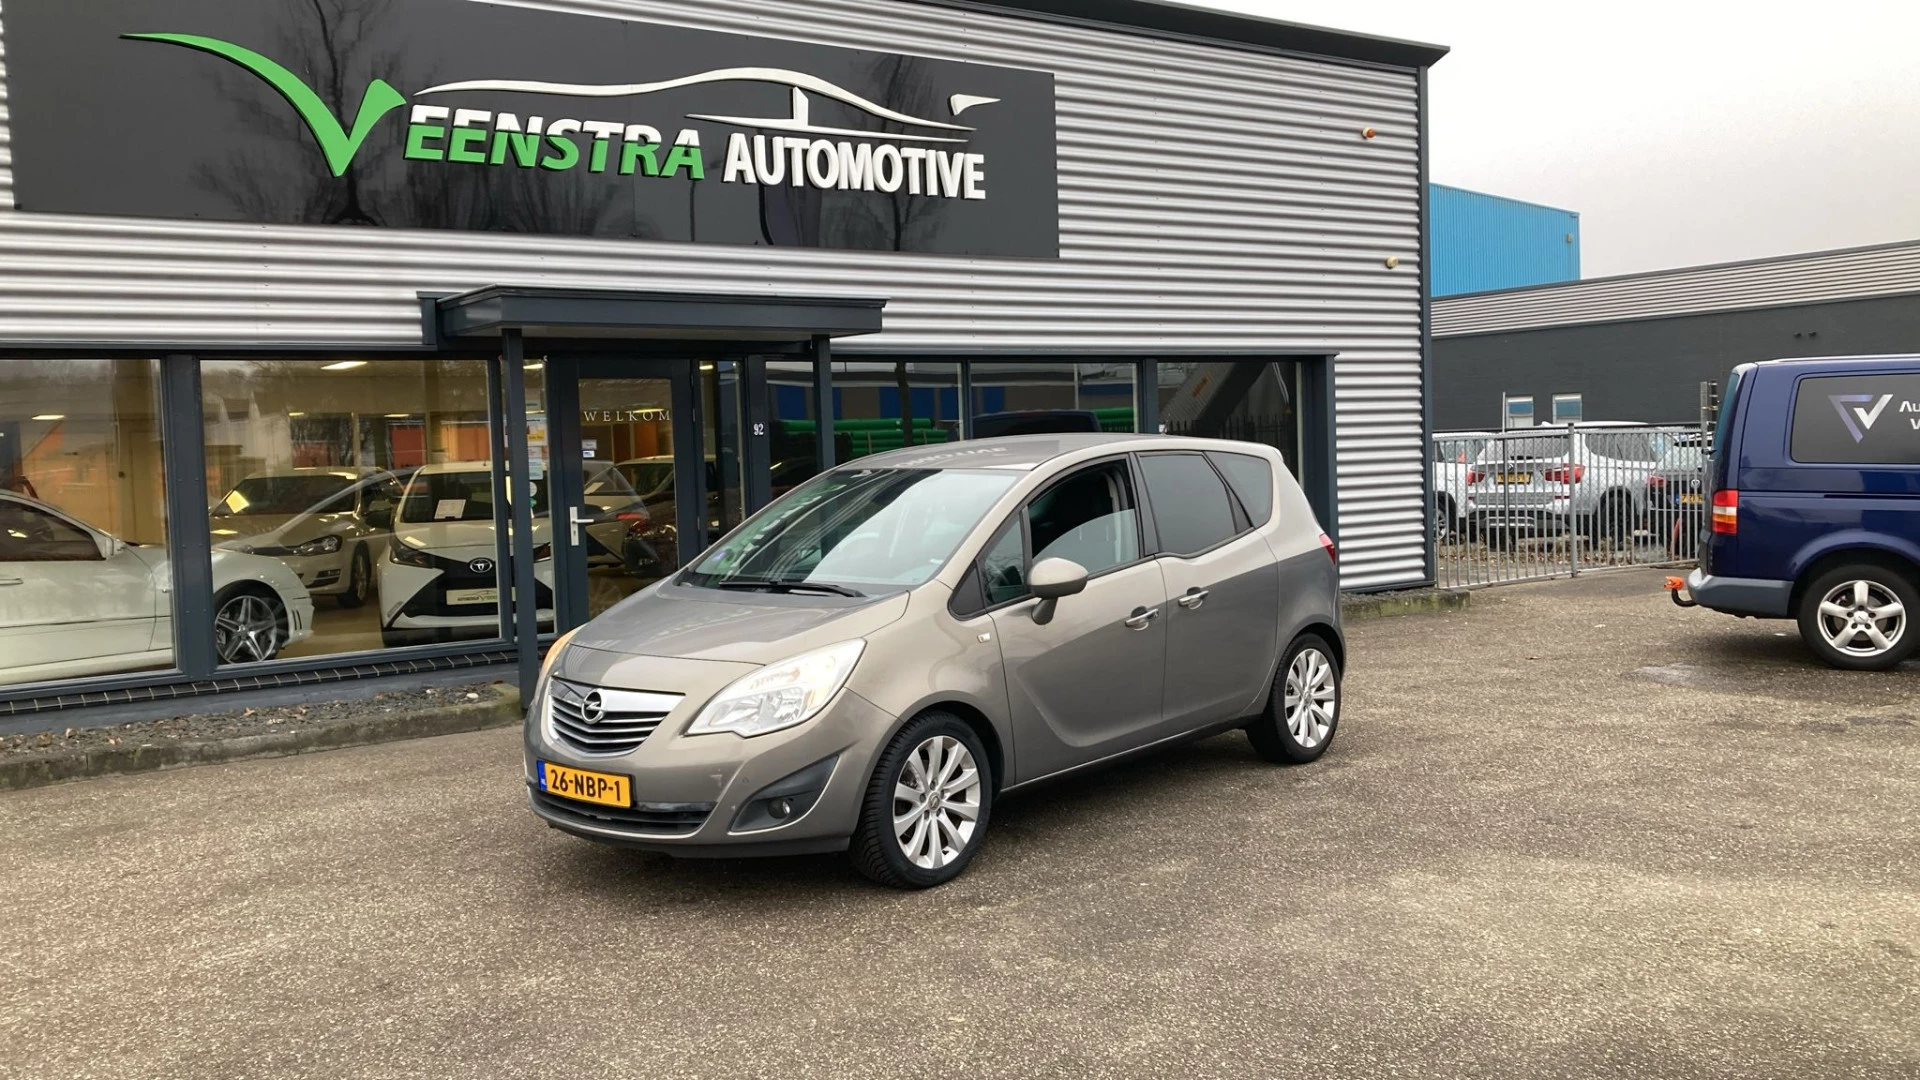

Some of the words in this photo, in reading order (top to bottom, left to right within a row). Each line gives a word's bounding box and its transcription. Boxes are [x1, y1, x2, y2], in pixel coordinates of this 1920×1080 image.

[723, 132, 986, 199] AUTOMOTIVE
[583, 410, 670, 422] WELKOM
[753, 423, 764, 435] 92
[550, 768, 621, 802] 26-NBP-1
